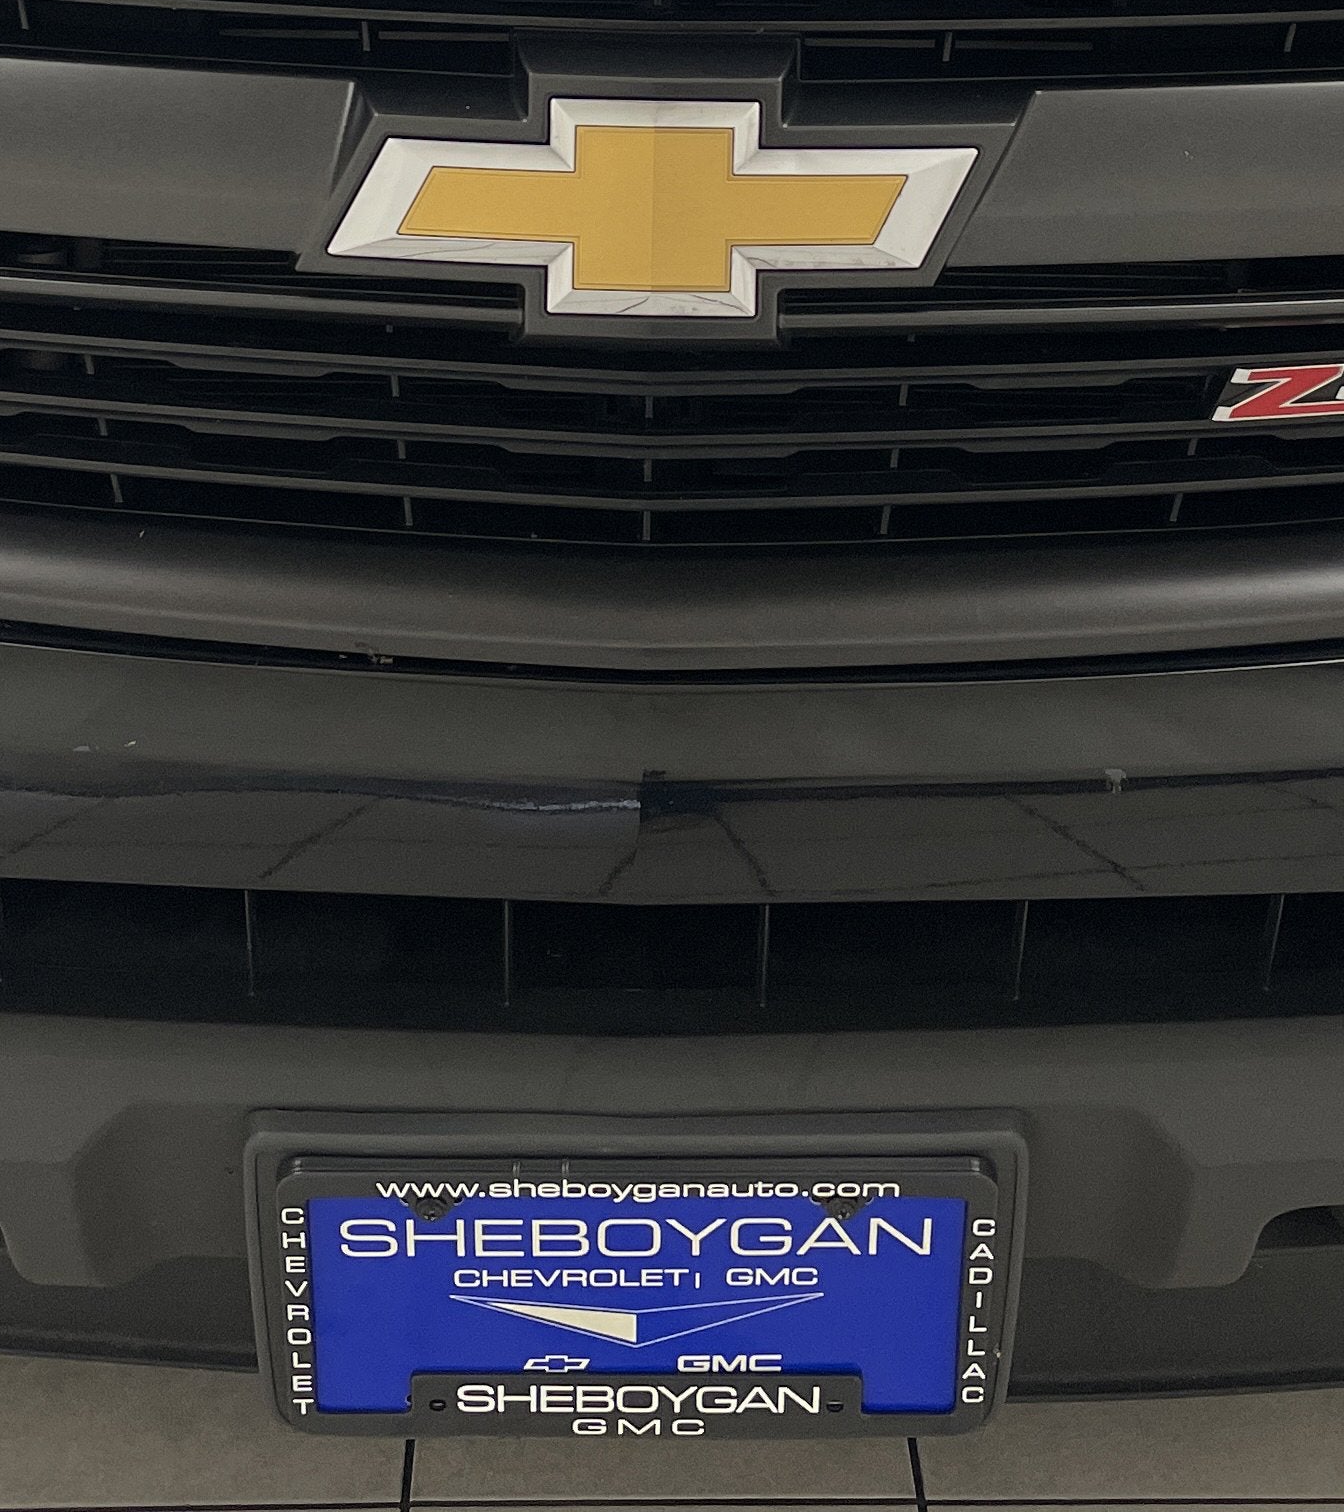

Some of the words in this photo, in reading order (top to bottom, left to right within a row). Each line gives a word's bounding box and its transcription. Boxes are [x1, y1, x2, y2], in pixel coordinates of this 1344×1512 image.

[375, 1178, 900, 1204] www.sheboyganauto.com
[338, 1217, 933, 1258] SHEBOYGAN
[453, 1268, 690, 1288] CHEVROLET
[725, 1267, 819, 1287] GMC
[281, 1207, 315, 1415] CHEVROLET
[961, 1218, 996, 1404] CADILLAC
[677, 1353, 783, 1373] GMC
[456, 1384, 821, 1414] SHEBOYGAN
[572, 1418, 706, 1437] GMC
